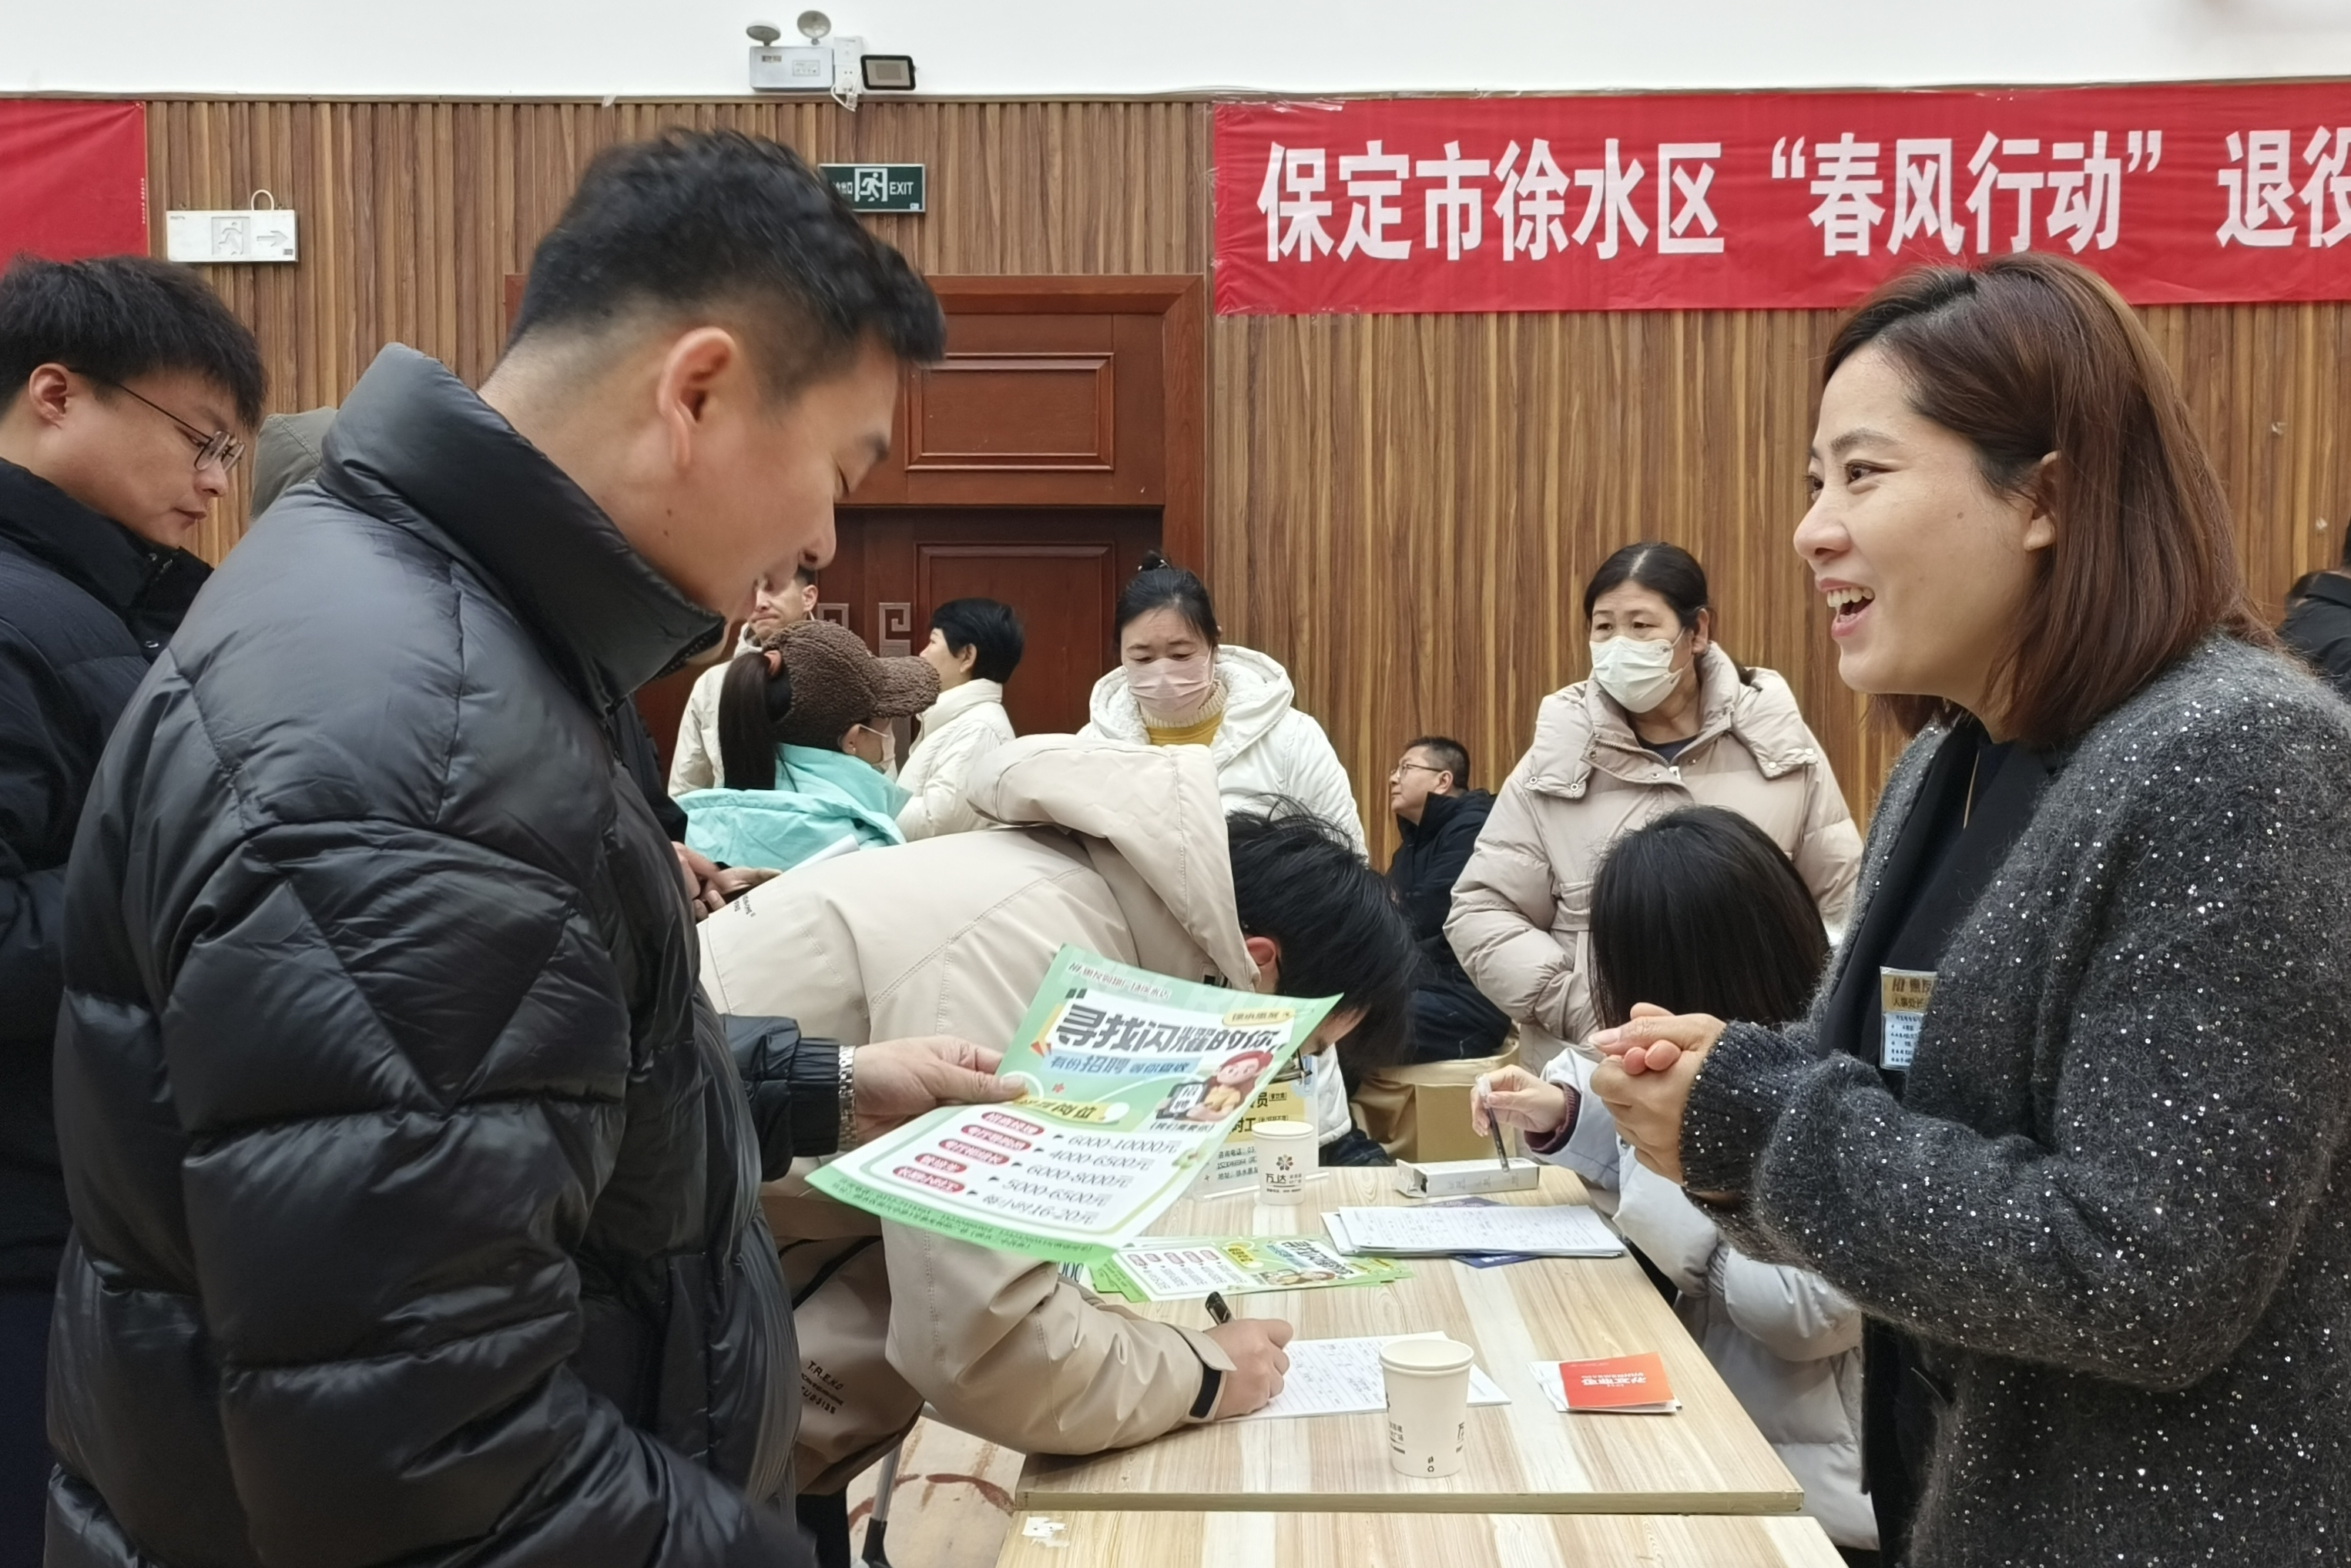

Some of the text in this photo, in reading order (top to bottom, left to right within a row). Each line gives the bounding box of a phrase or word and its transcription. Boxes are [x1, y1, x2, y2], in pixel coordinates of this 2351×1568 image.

[890, 182, 914, 195] EXIT
[1256, 126, 2351, 263] 保定市徐水区 “春风行动” 退役
